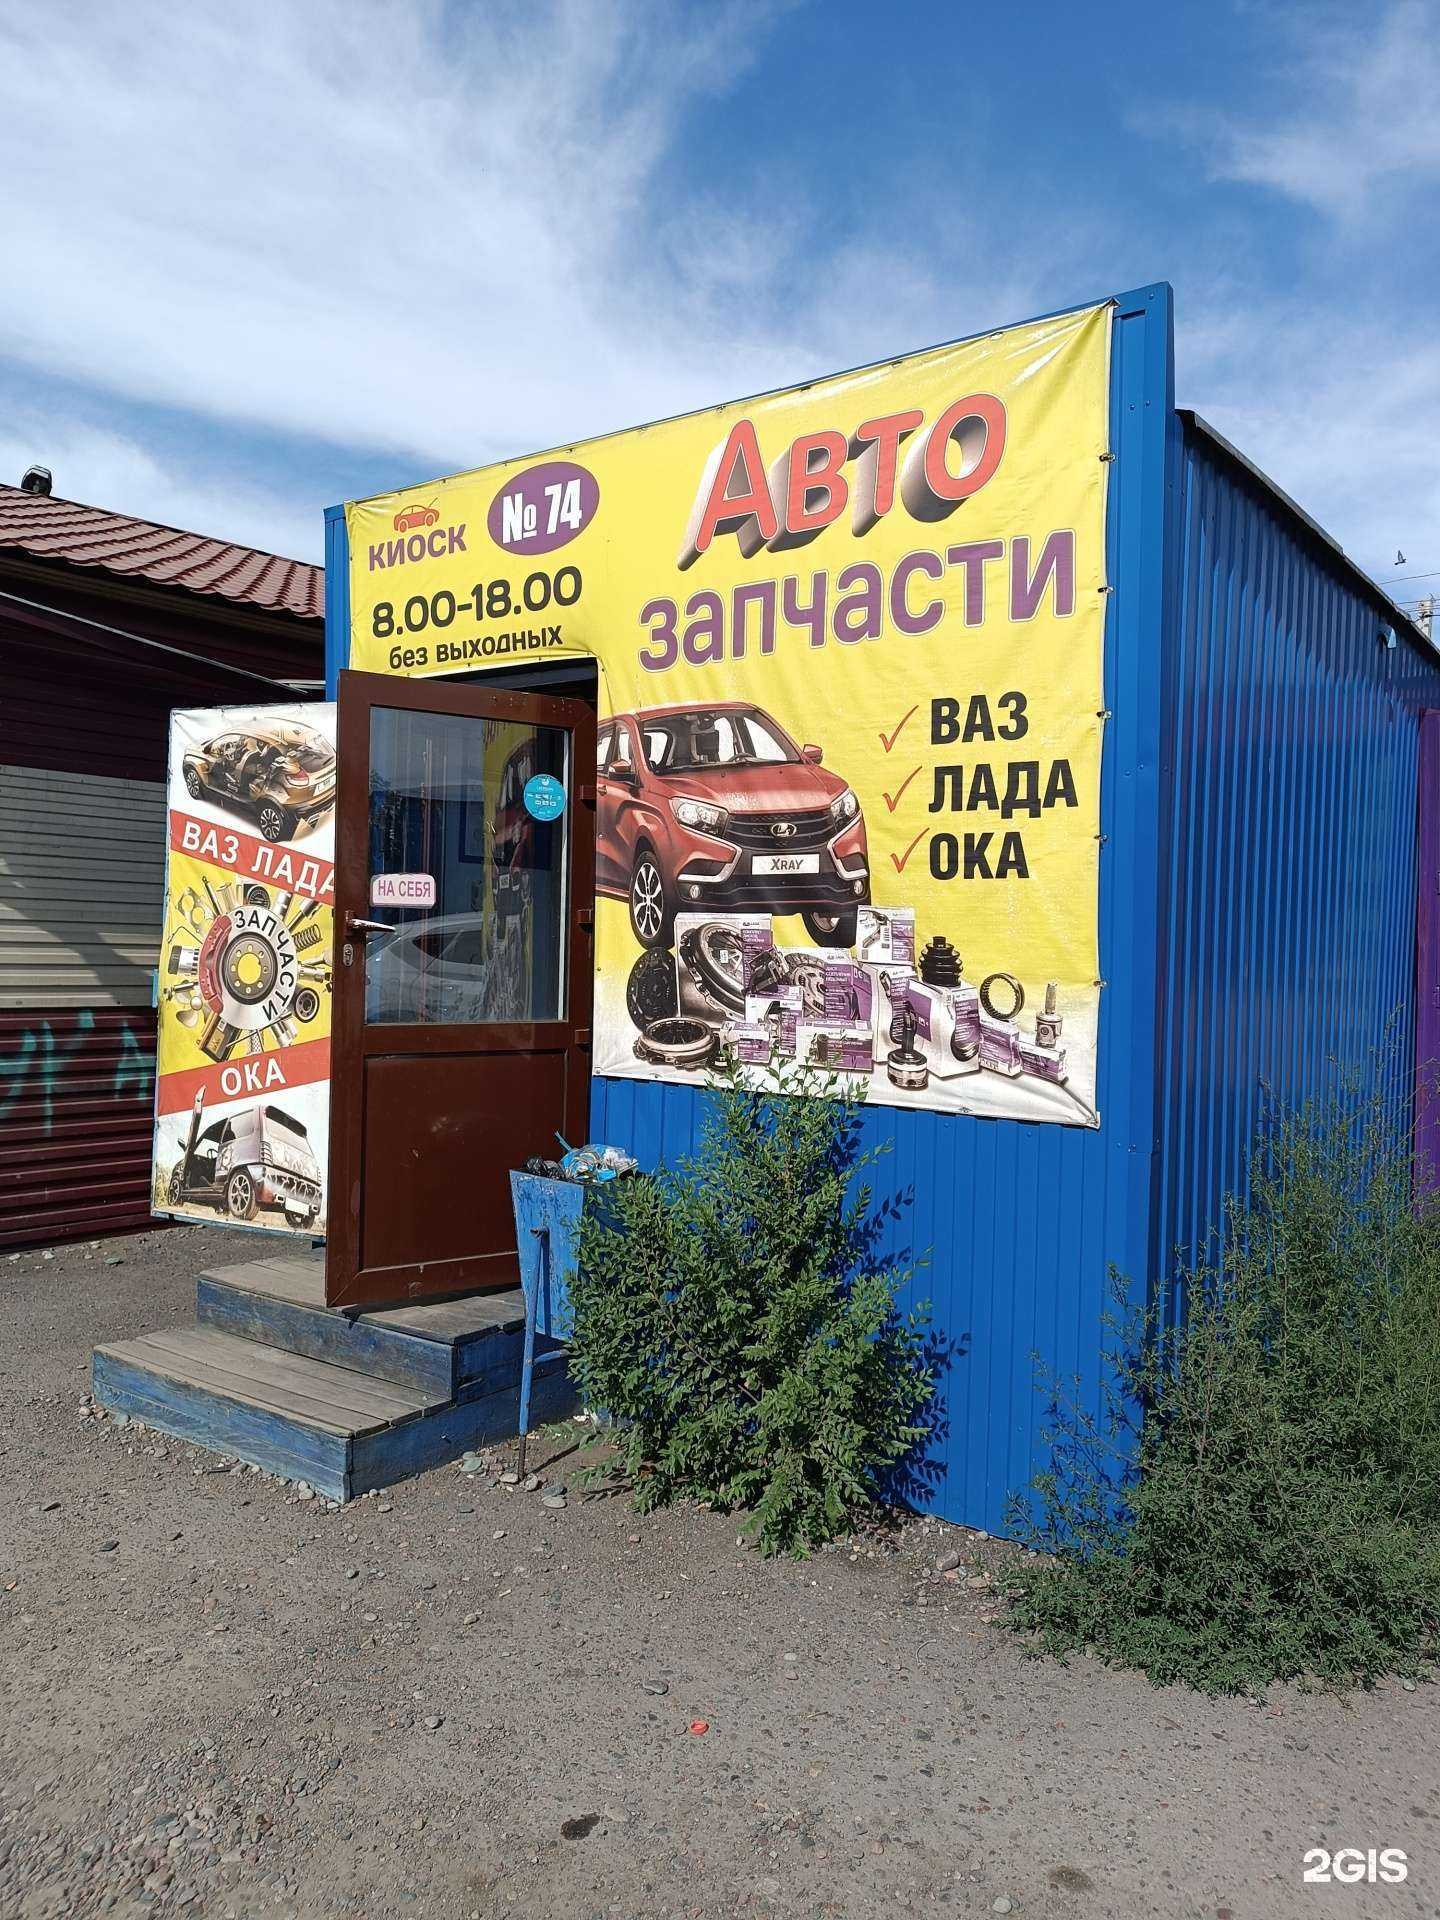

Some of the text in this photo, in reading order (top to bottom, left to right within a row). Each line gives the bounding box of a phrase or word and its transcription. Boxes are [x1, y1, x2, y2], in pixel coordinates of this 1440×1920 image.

[544, 479, 582, 534] 74
[677, 393, 1007, 571] Авто
[368, 523, 467, 571] КИОСК
[372, 566, 583, 638] 8.00-18.00
[638, 528, 1076, 672] запчасти
[389, 625, 563, 669] без выходных
[931, 691, 1029, 745] ВАЗ
[928, 759, 1079, 819] ЛАДА
[182, 821, 240, 865] ВАЗ
[929, 832, 1030, 880] ОКА
[378, 880, 431, 898] НА СЕБЯ
[234, 909, 295, 1022] ЗАПЧАСТИ
[220, 1057, 286, 1097] ОКА
